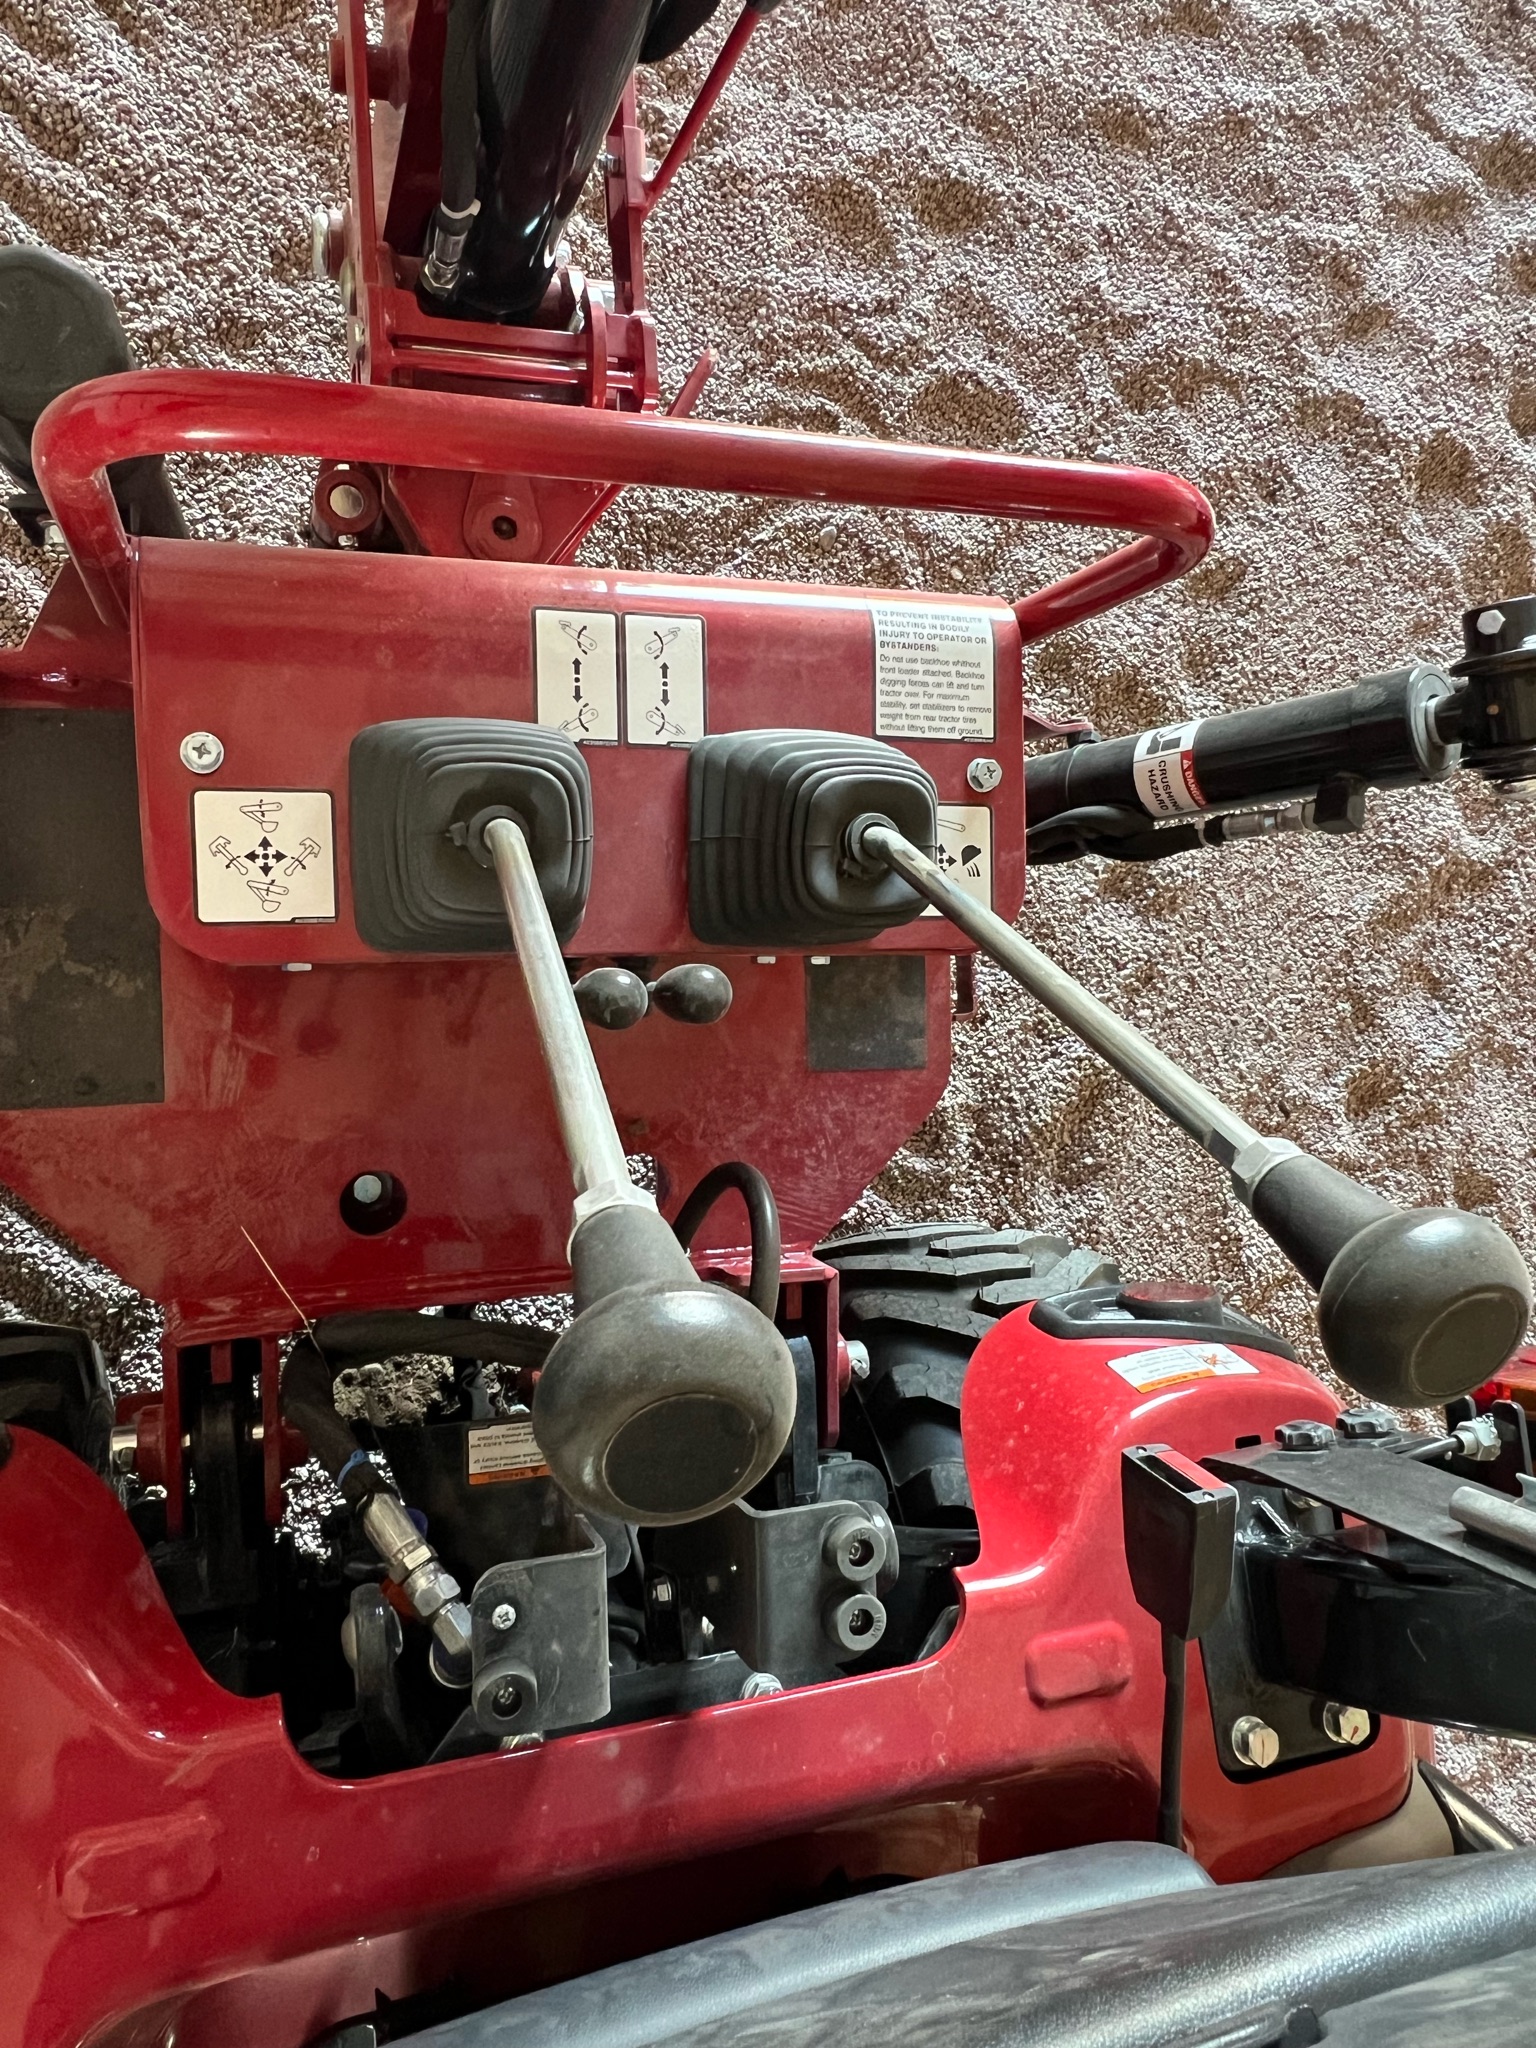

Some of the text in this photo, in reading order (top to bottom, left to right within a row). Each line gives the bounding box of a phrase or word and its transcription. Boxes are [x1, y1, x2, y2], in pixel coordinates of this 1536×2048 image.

[890, 611, 929, 619] PREVENT
[931, 614, 983, 623] INSTABILITY
[878, 619, 927, 630] RESULTING
[940, 624, 969, 632] BODILY
[879, 630, 987, 644] INJURY TO OPERATOR OR
[879, 640, 939, 652] BYSTANDERS:
[880, 654, 890, 662] Do
[892, 655, 904, 663] not
[905, 657, 919, 665] use
[920, 657, 950, 667] backhoe
[880, 665, 896, 673] front
[898, 667, 919, 675] loader
[955, 670, 985, 680] Backhoe
[880, 677, 906, 687] digging
[908, 678, 930, 687] forces
[946, 681, 955, 689] lift
[956, 682, 969, 690] and
[880, 688, 902, 696] tractor
[923, 691, 934, 699] For
[936, 693, 970, 701] maximum
[922, 703, 956, 712] stabilizers
[958, 704, 965, 712] to
[967, 705, 992, 713] remove
[880, 712, 903, 722] weight
[938, 714, 960, 723] tractor
[962, 716, 977, 724] tires
[880, 723, 905, 731] without
[907, 724, 925, 734] lifting
[947, 726, 957, 735] off
[1148, 769, 1169, 811] HAZARD
[1158, 760, 1185, 812] CRUSHING
[1185, 770, 1206, 806] DANGER
